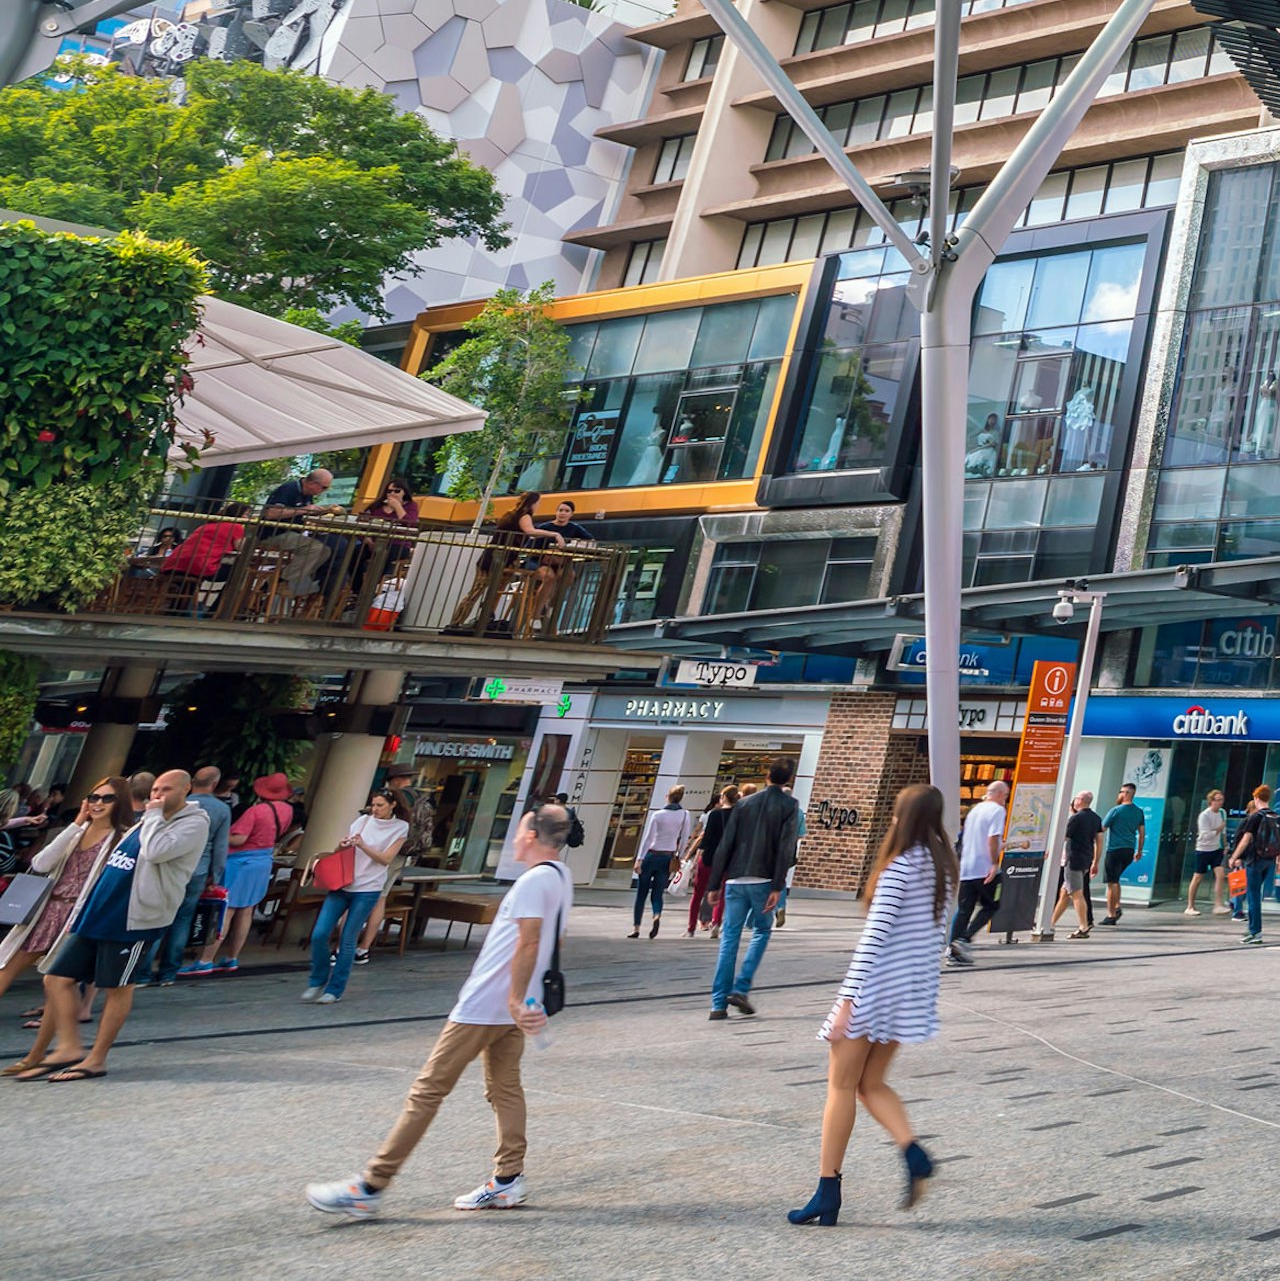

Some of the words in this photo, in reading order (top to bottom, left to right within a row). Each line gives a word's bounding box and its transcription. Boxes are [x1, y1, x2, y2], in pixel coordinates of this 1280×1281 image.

[695, 662, 747, 685] Typo
[508, 686, 559, 695] PHARMACY
[625, 700, 724, 719] PHARMACY
[1173, 707, 1248, 736] citibank
[818, 800, 858, 830] Typo
